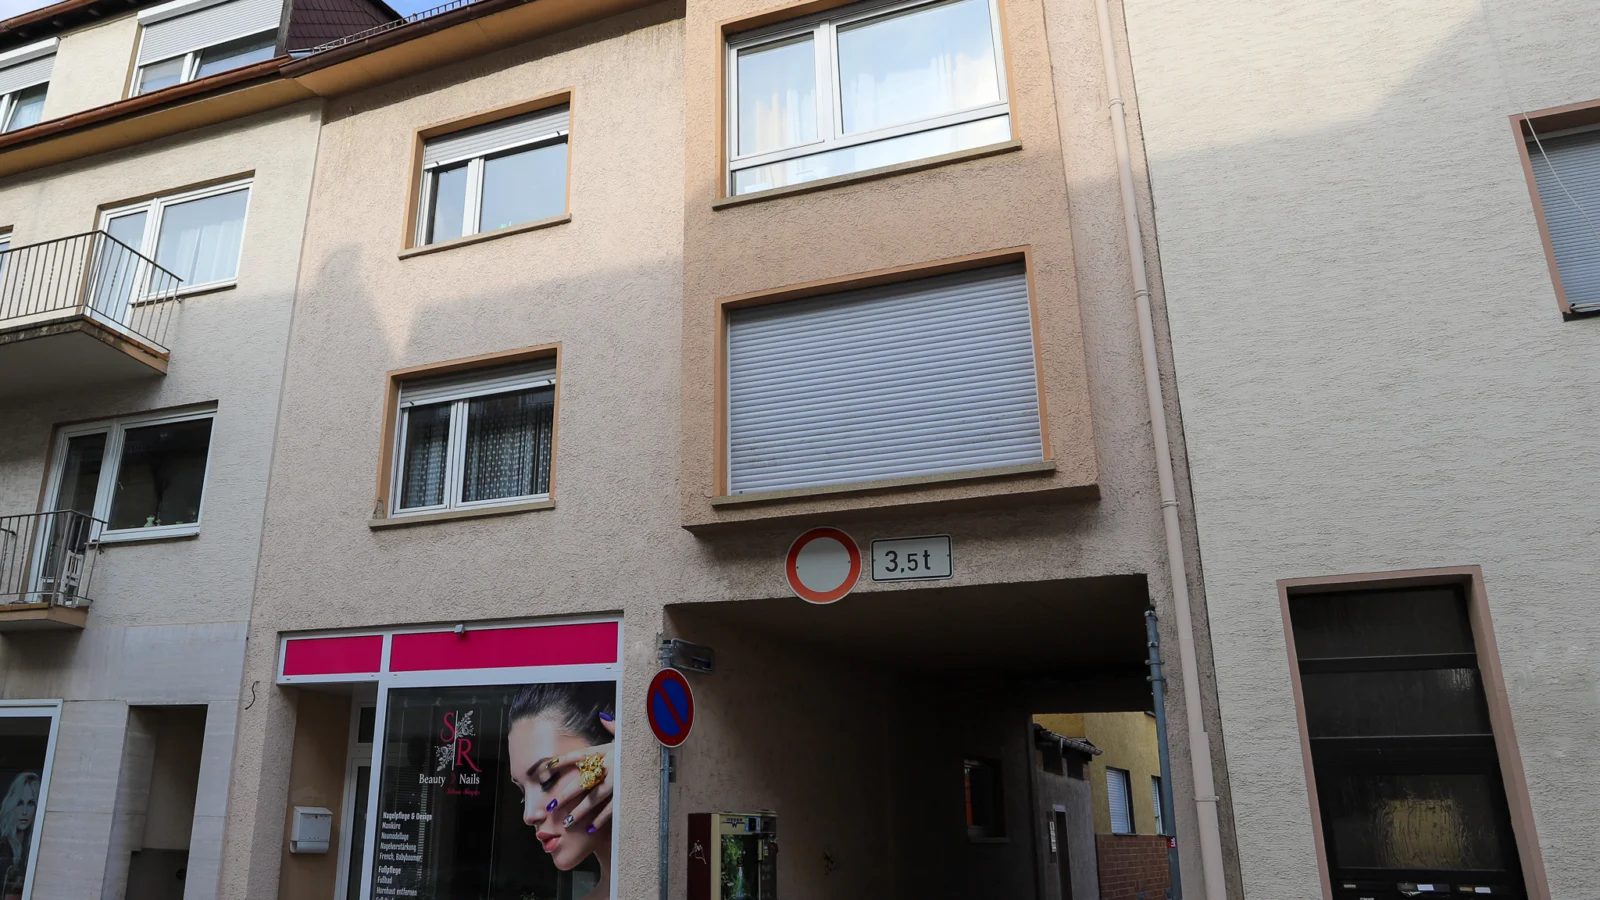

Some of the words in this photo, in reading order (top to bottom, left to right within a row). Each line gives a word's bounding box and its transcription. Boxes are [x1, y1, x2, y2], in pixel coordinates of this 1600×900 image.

[440, 712, 454, 742] S
[456, 738, 483, 772] R
[419, 773, 446, 787] Beauty
[459, 773, 480, 785] Nails
[383, 812, 410, 820] Nagelpflege
[416, 813, 432, 822] Design
[380, 842, 416, 852] Nagelverstärkung
[379, 852, 395, 861] French,
[378, 866, 401, 875] Fußpflege
